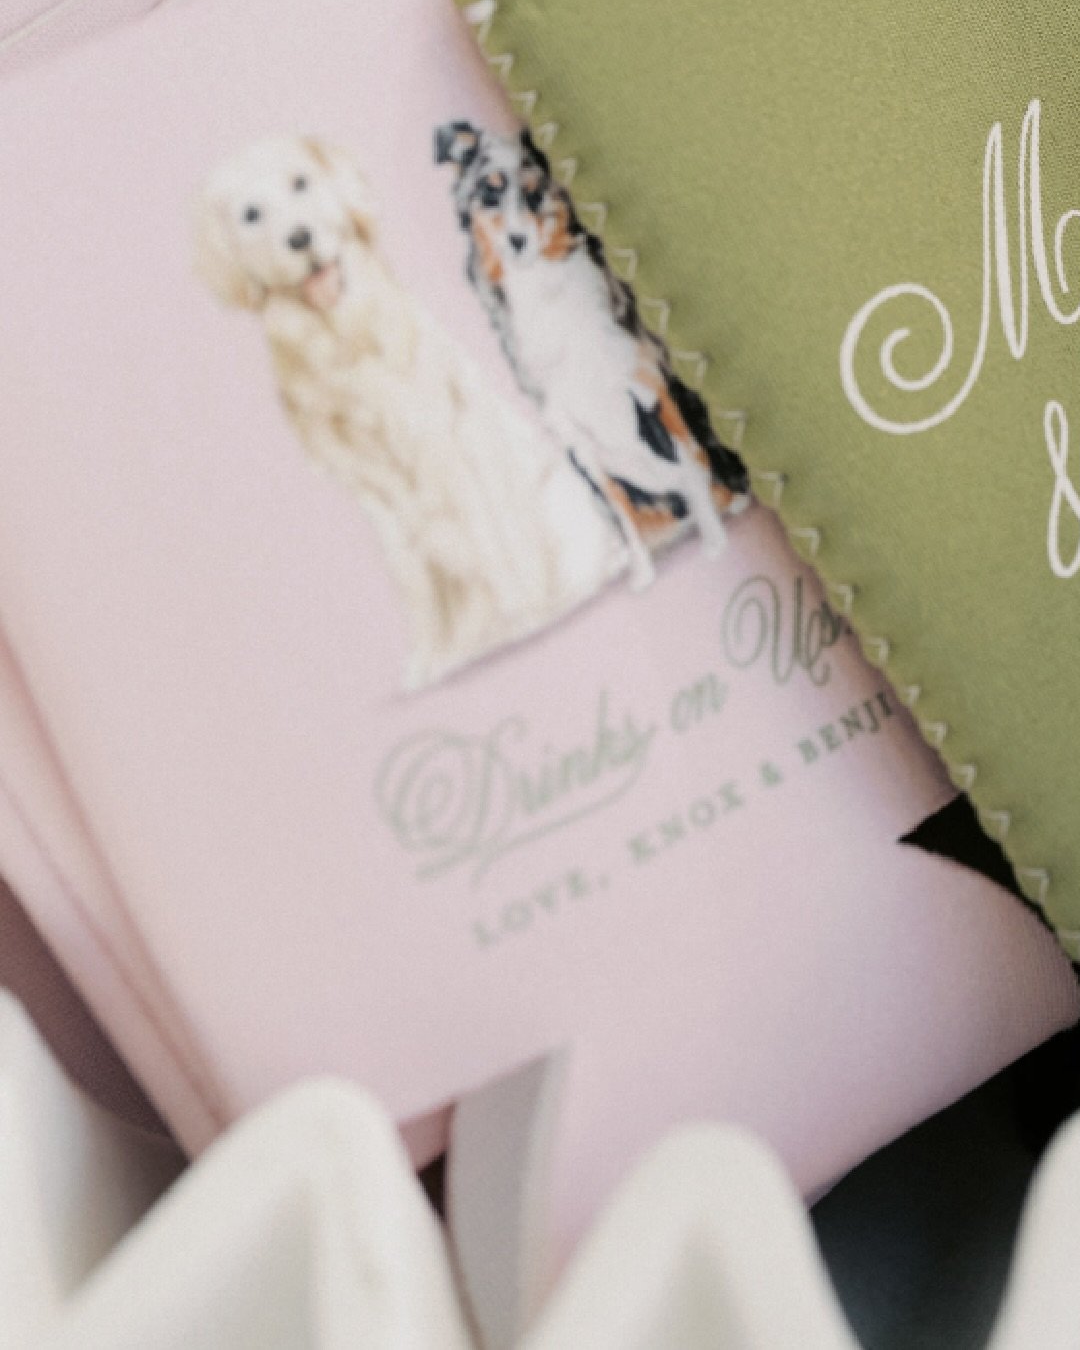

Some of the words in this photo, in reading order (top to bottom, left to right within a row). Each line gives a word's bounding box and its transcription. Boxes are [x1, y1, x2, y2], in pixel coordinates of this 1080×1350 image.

[373, 687, 657, 889] Drinks
[669, 671, 730, 735] on
[470, 865, 612, 953] LOVE,
[626, 777, 746, 868] KNOX
[756, 758, 785, 789] &
[796, 691, 893, 765] BENJI
